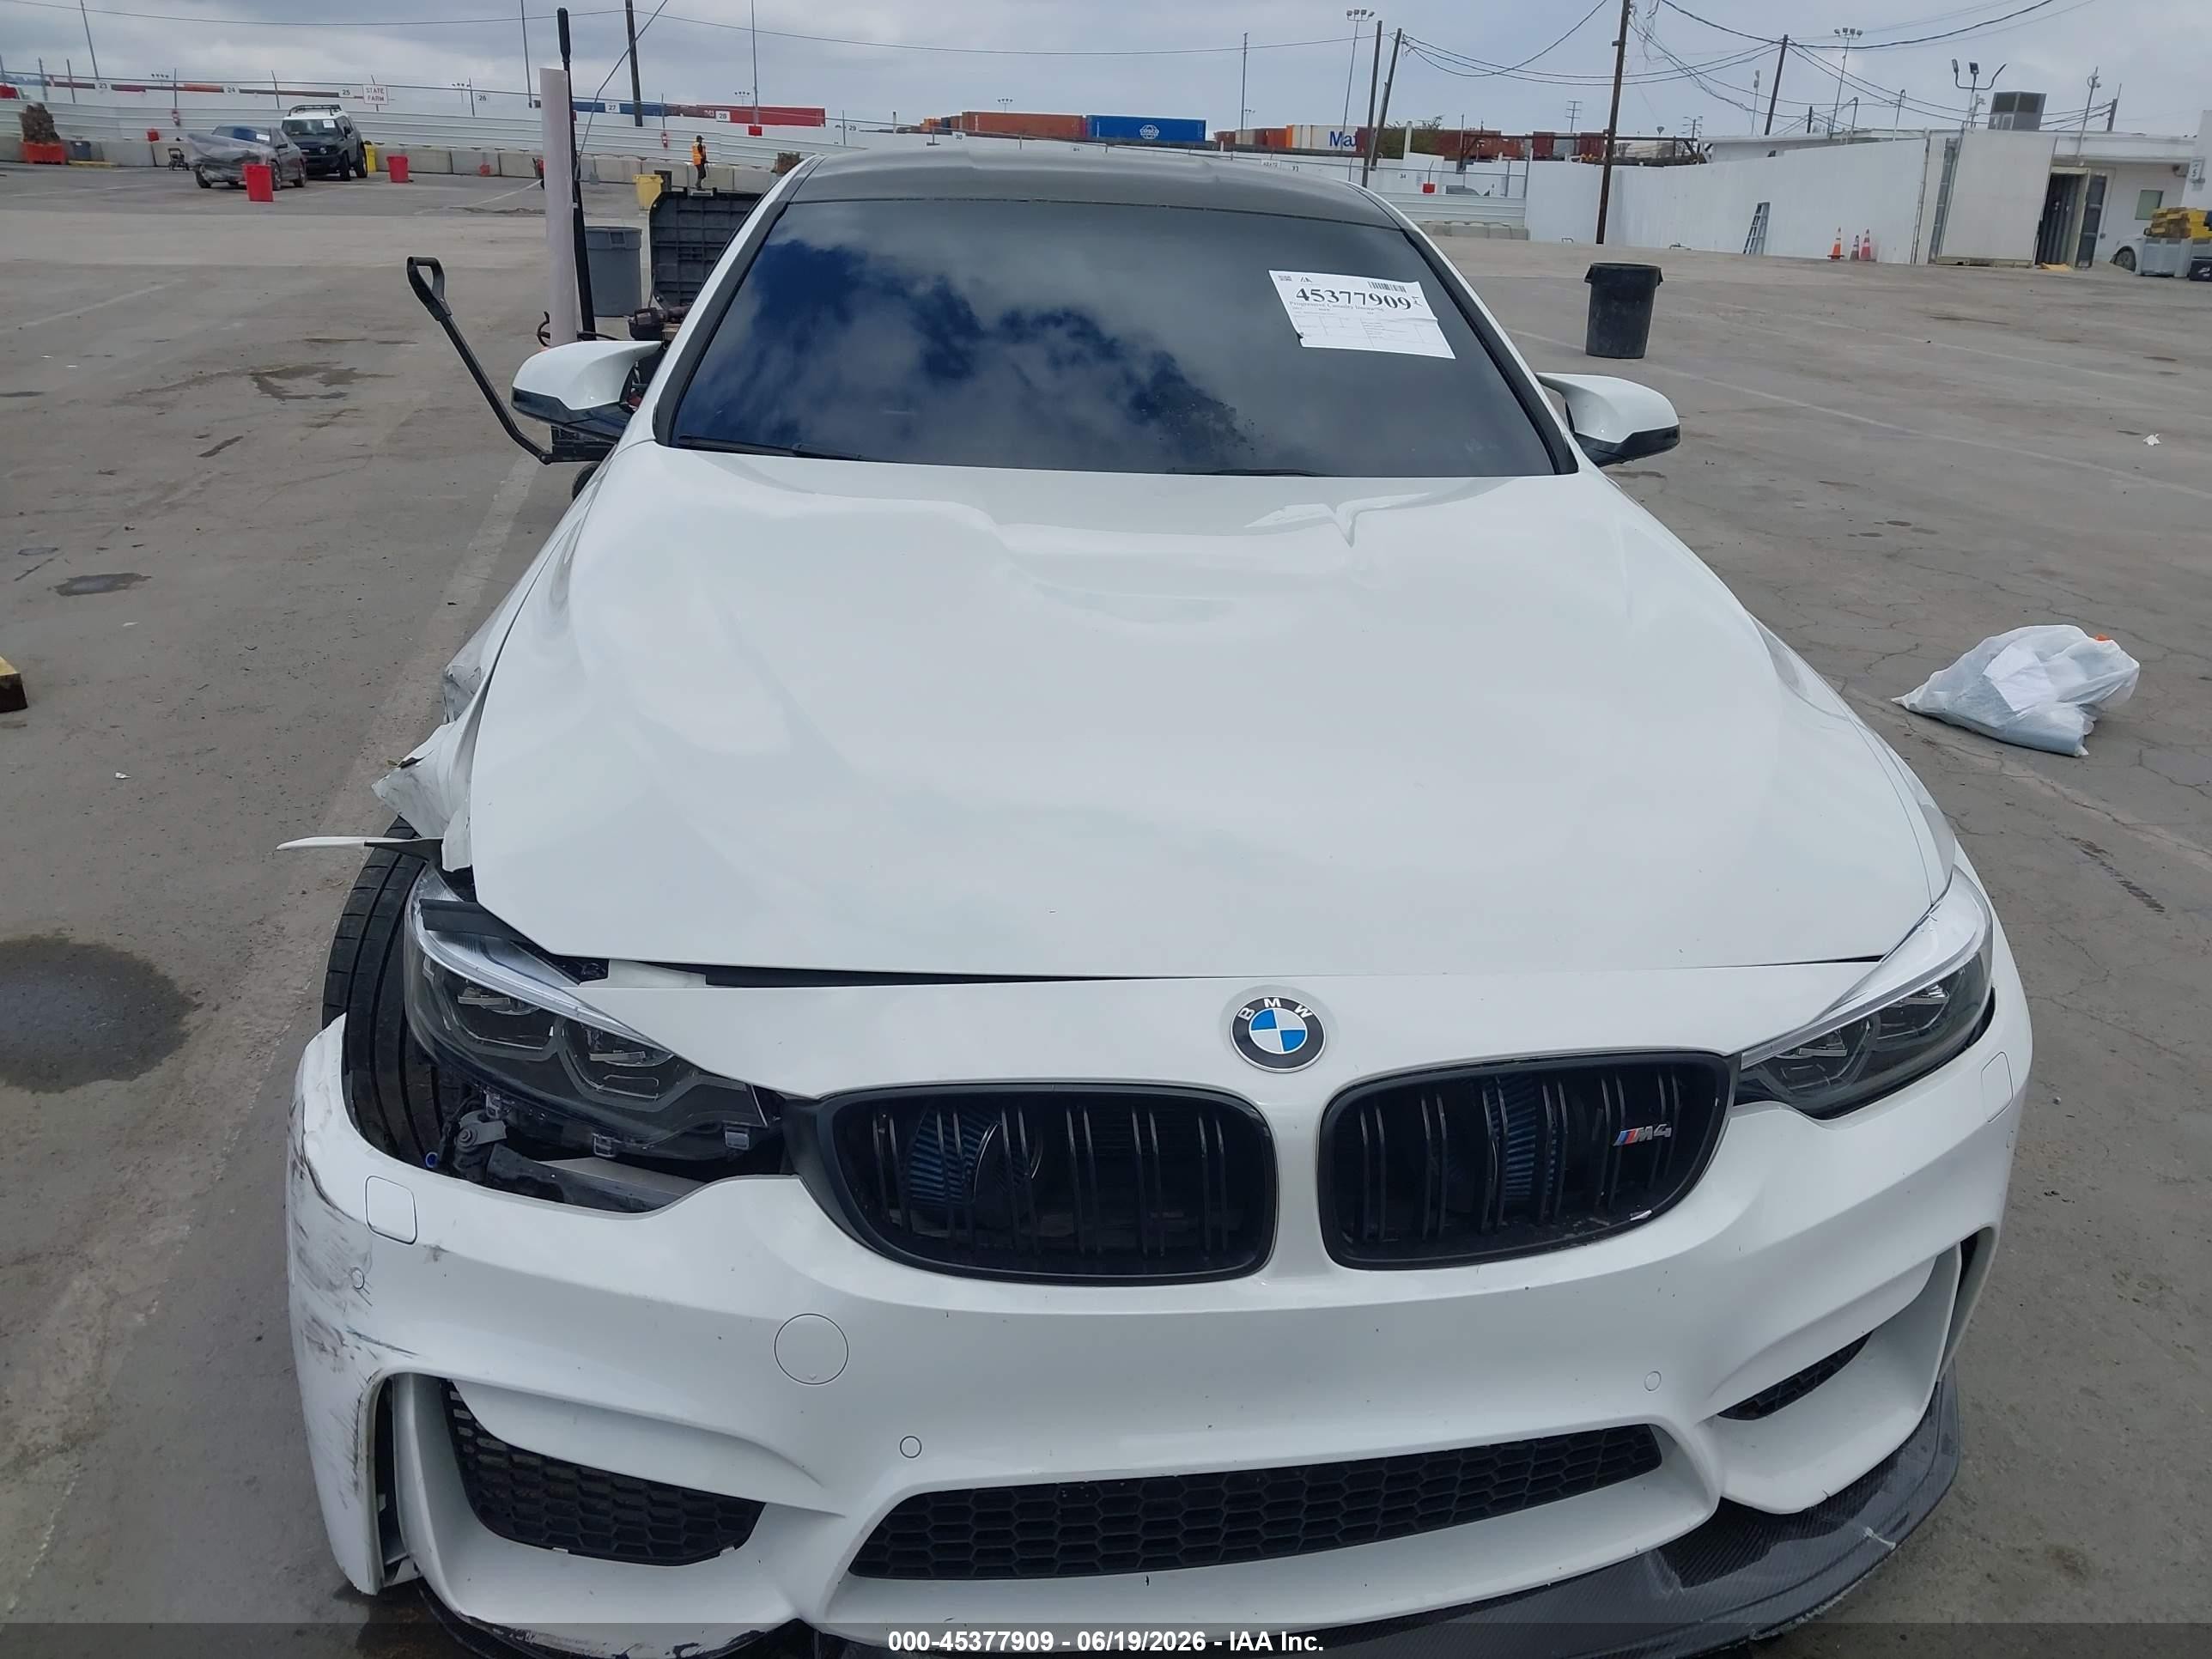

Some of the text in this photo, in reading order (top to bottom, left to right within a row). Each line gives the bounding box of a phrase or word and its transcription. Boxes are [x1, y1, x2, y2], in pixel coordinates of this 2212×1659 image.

[1295, 288, 1411, 310] 45377909
[1237, 998, 1313, 1021] BMW
[1632, 1123, 1672, 1143] M4
